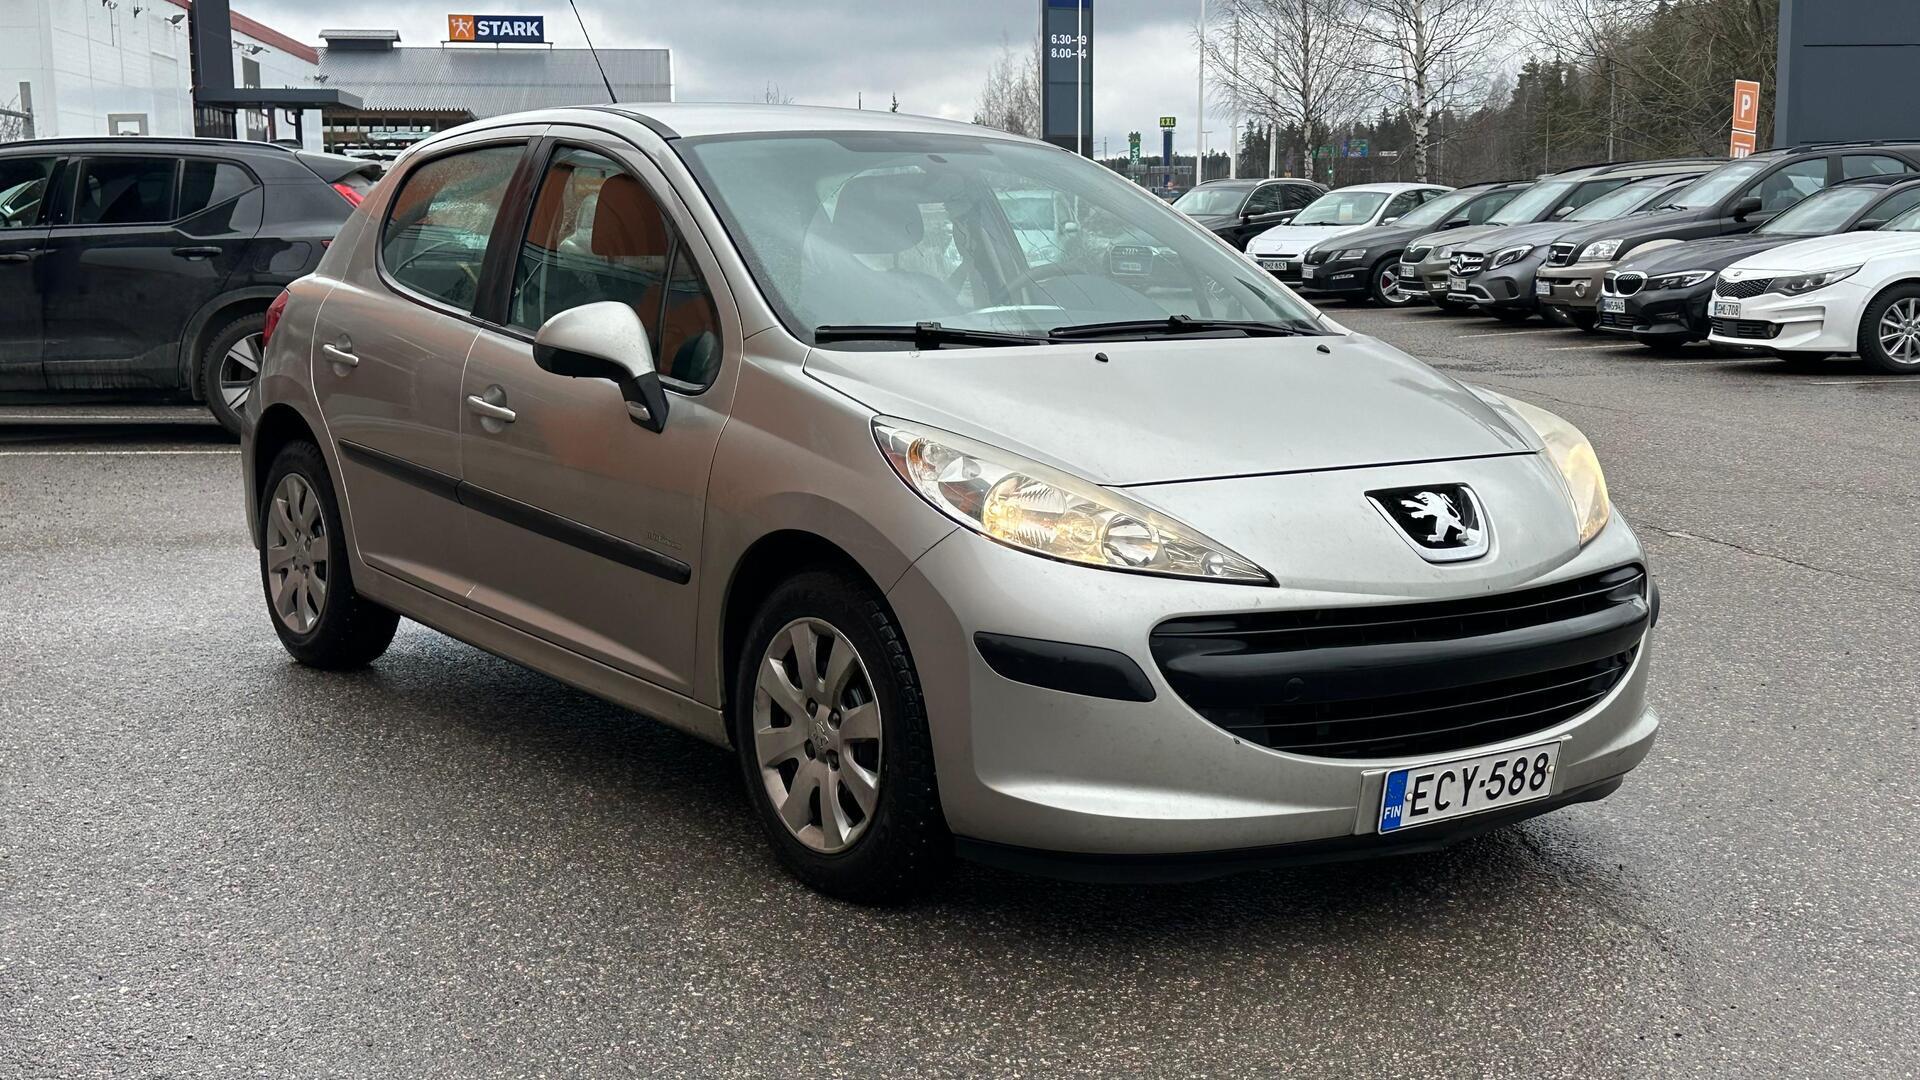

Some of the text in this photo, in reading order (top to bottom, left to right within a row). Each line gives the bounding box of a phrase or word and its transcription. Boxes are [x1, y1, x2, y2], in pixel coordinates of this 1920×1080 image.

[477, 21, 540, 36] STARK
[1741, 94, 1751, 118] P
[1160, 118, 1175, 126] XXL
[1409, 752, 1549, 817] ECY-588
[1384, 804, 1402, 820] FIN
